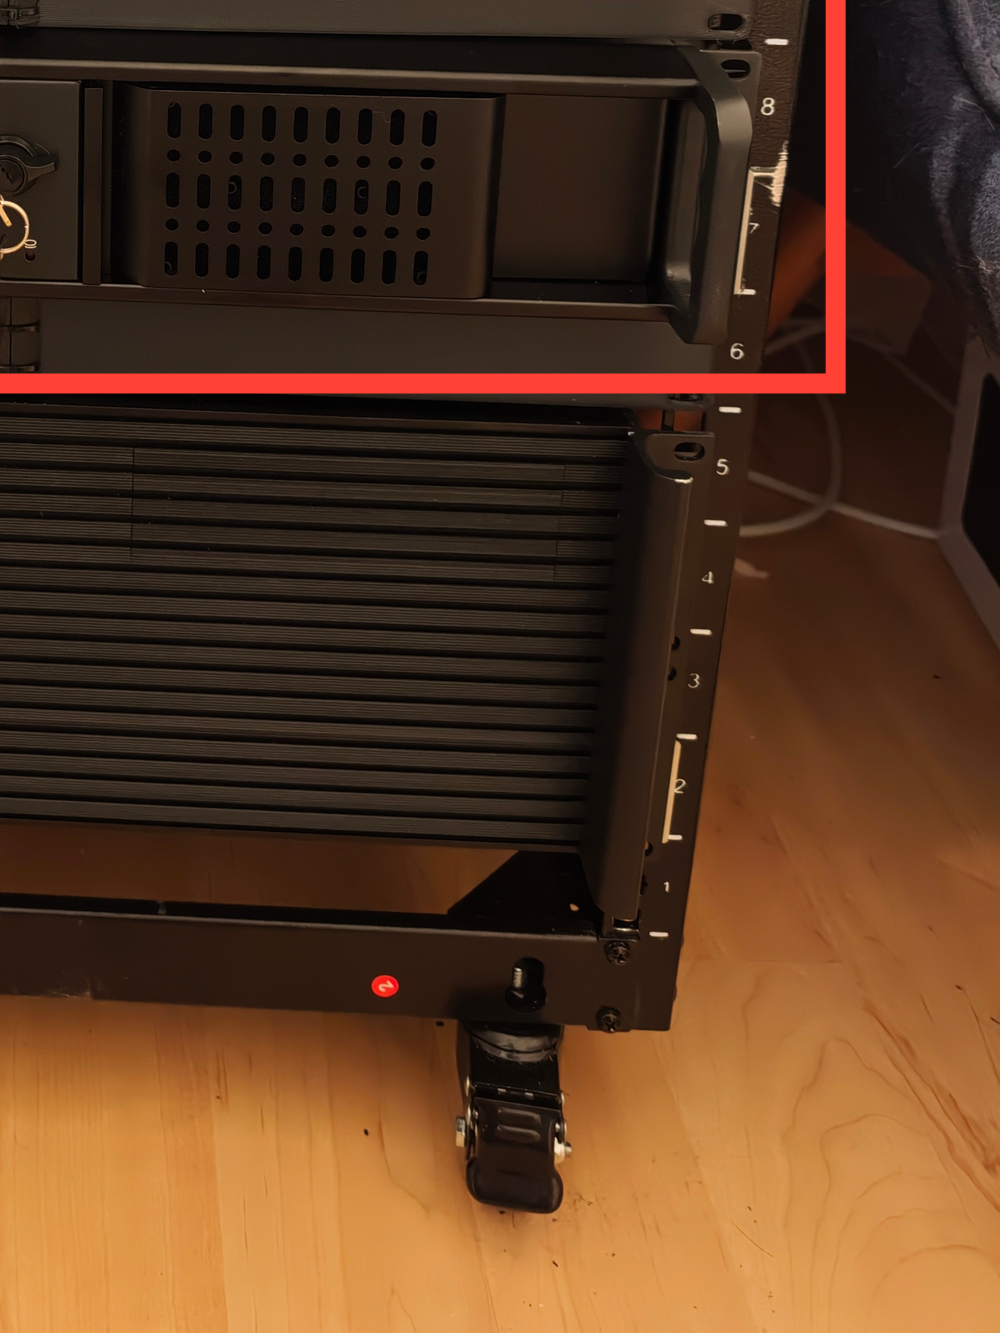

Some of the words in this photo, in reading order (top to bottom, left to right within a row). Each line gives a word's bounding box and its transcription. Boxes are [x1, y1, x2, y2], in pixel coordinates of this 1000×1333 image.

[760, 97, 776, 116] 8
[729, 342, 745, 360] 6
[716, 458, 729, 476] 5
[701, 571, 714, 585] 4
[687, 672, 700, 689] 3
[673, 779, 686, 794] 2
[663, 881, 671, 893] 1
